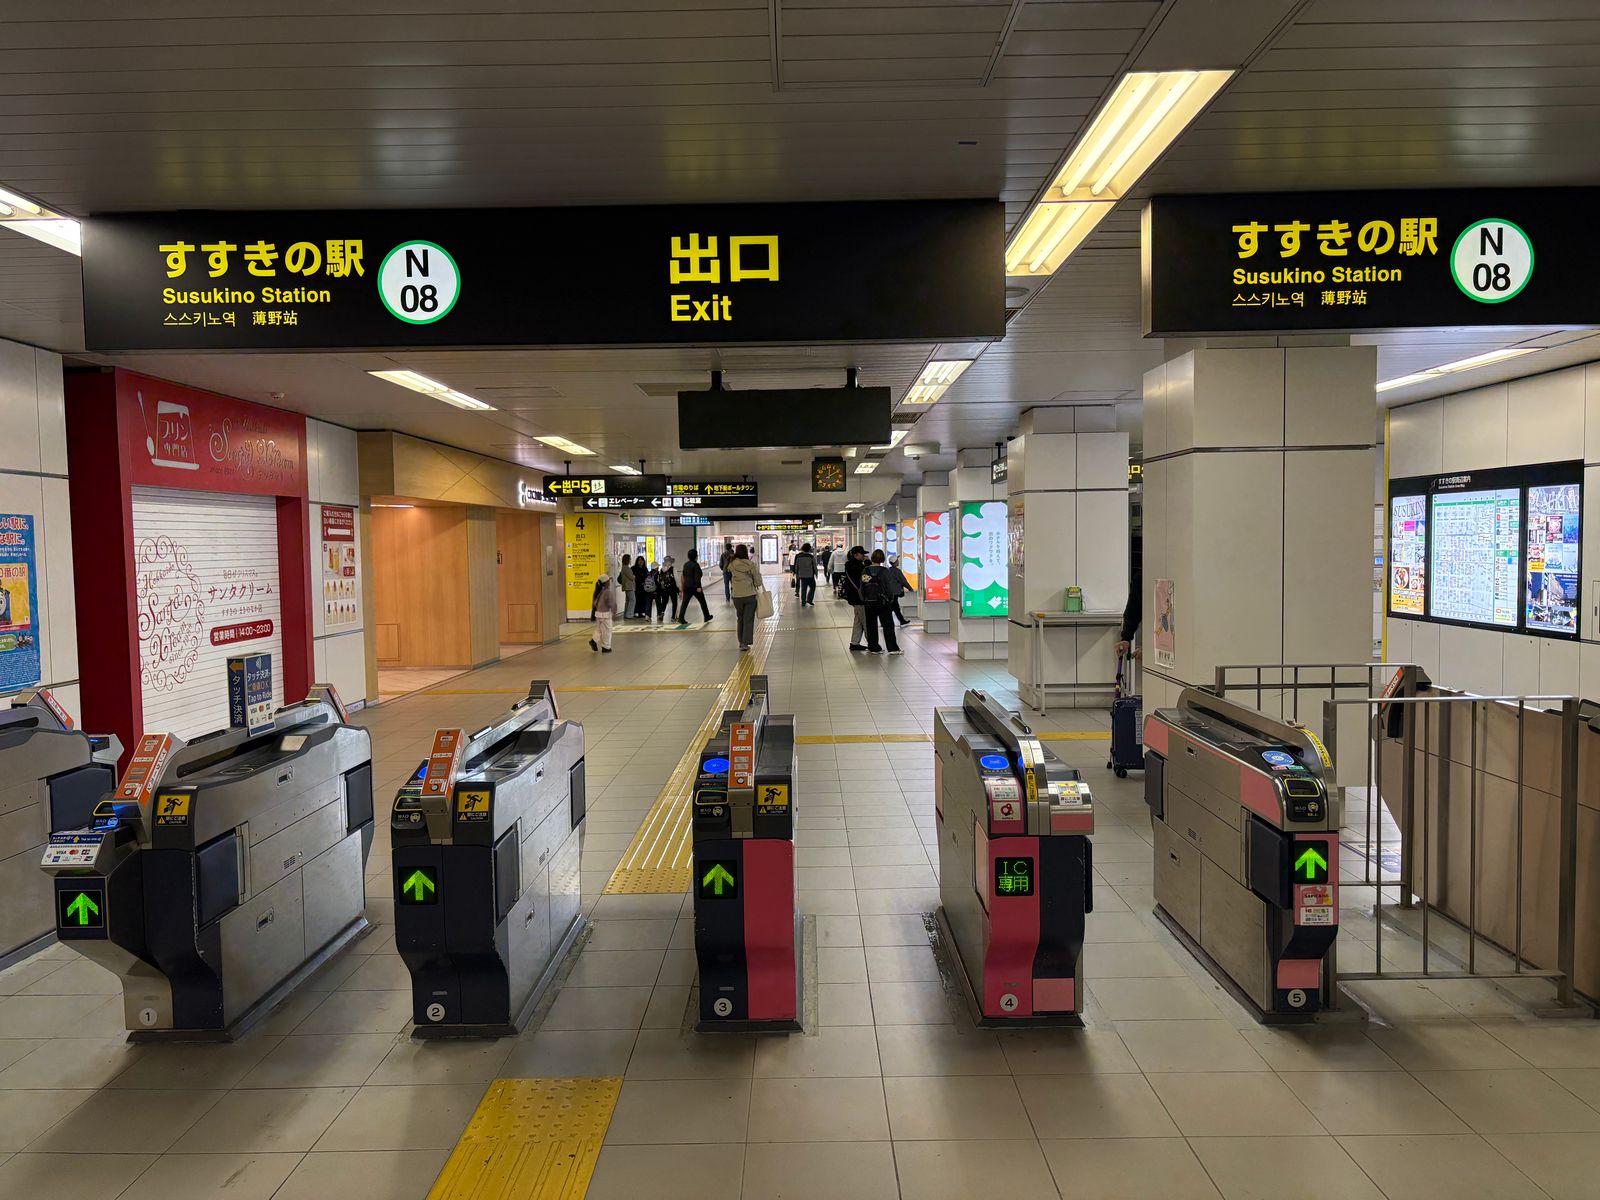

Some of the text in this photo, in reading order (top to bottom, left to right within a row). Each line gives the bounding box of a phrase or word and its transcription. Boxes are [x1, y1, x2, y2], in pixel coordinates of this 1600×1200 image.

[1232, 217, 1438, 259] すすきの駅
[1479, 227, 1504, 256] N
[158, 239, 365, 279] すすきの駅
[405, 249, 428, 278] N
[669, 232, 780, 285] 出口
[1232, 265, 1402, 285] Susukino Station
[1472, 262, 1511, 292] 08
[162, 286, 331, 305] Susukino Station
[400, 284, 438, 314] 08
[1232, 289, 1368, 308] 스스키노역 薄野站
[670, 293, 733, 322] Exit
[163, 309, 298, 328] 스스키노역 薄野站
[562, 480, 591, 494] 出口 5
[575, 517, 585, 530] 4
[207, 581, 273, 603] サンタクリーム
[719, 1002, 727, 1012] 3
[1004, 998, 1014, 1007] 4
[1293, 994, 1302, 1003] 5
[145, 1011, 150, 1022] 1
[432, 1007, 441, 1017] 2
